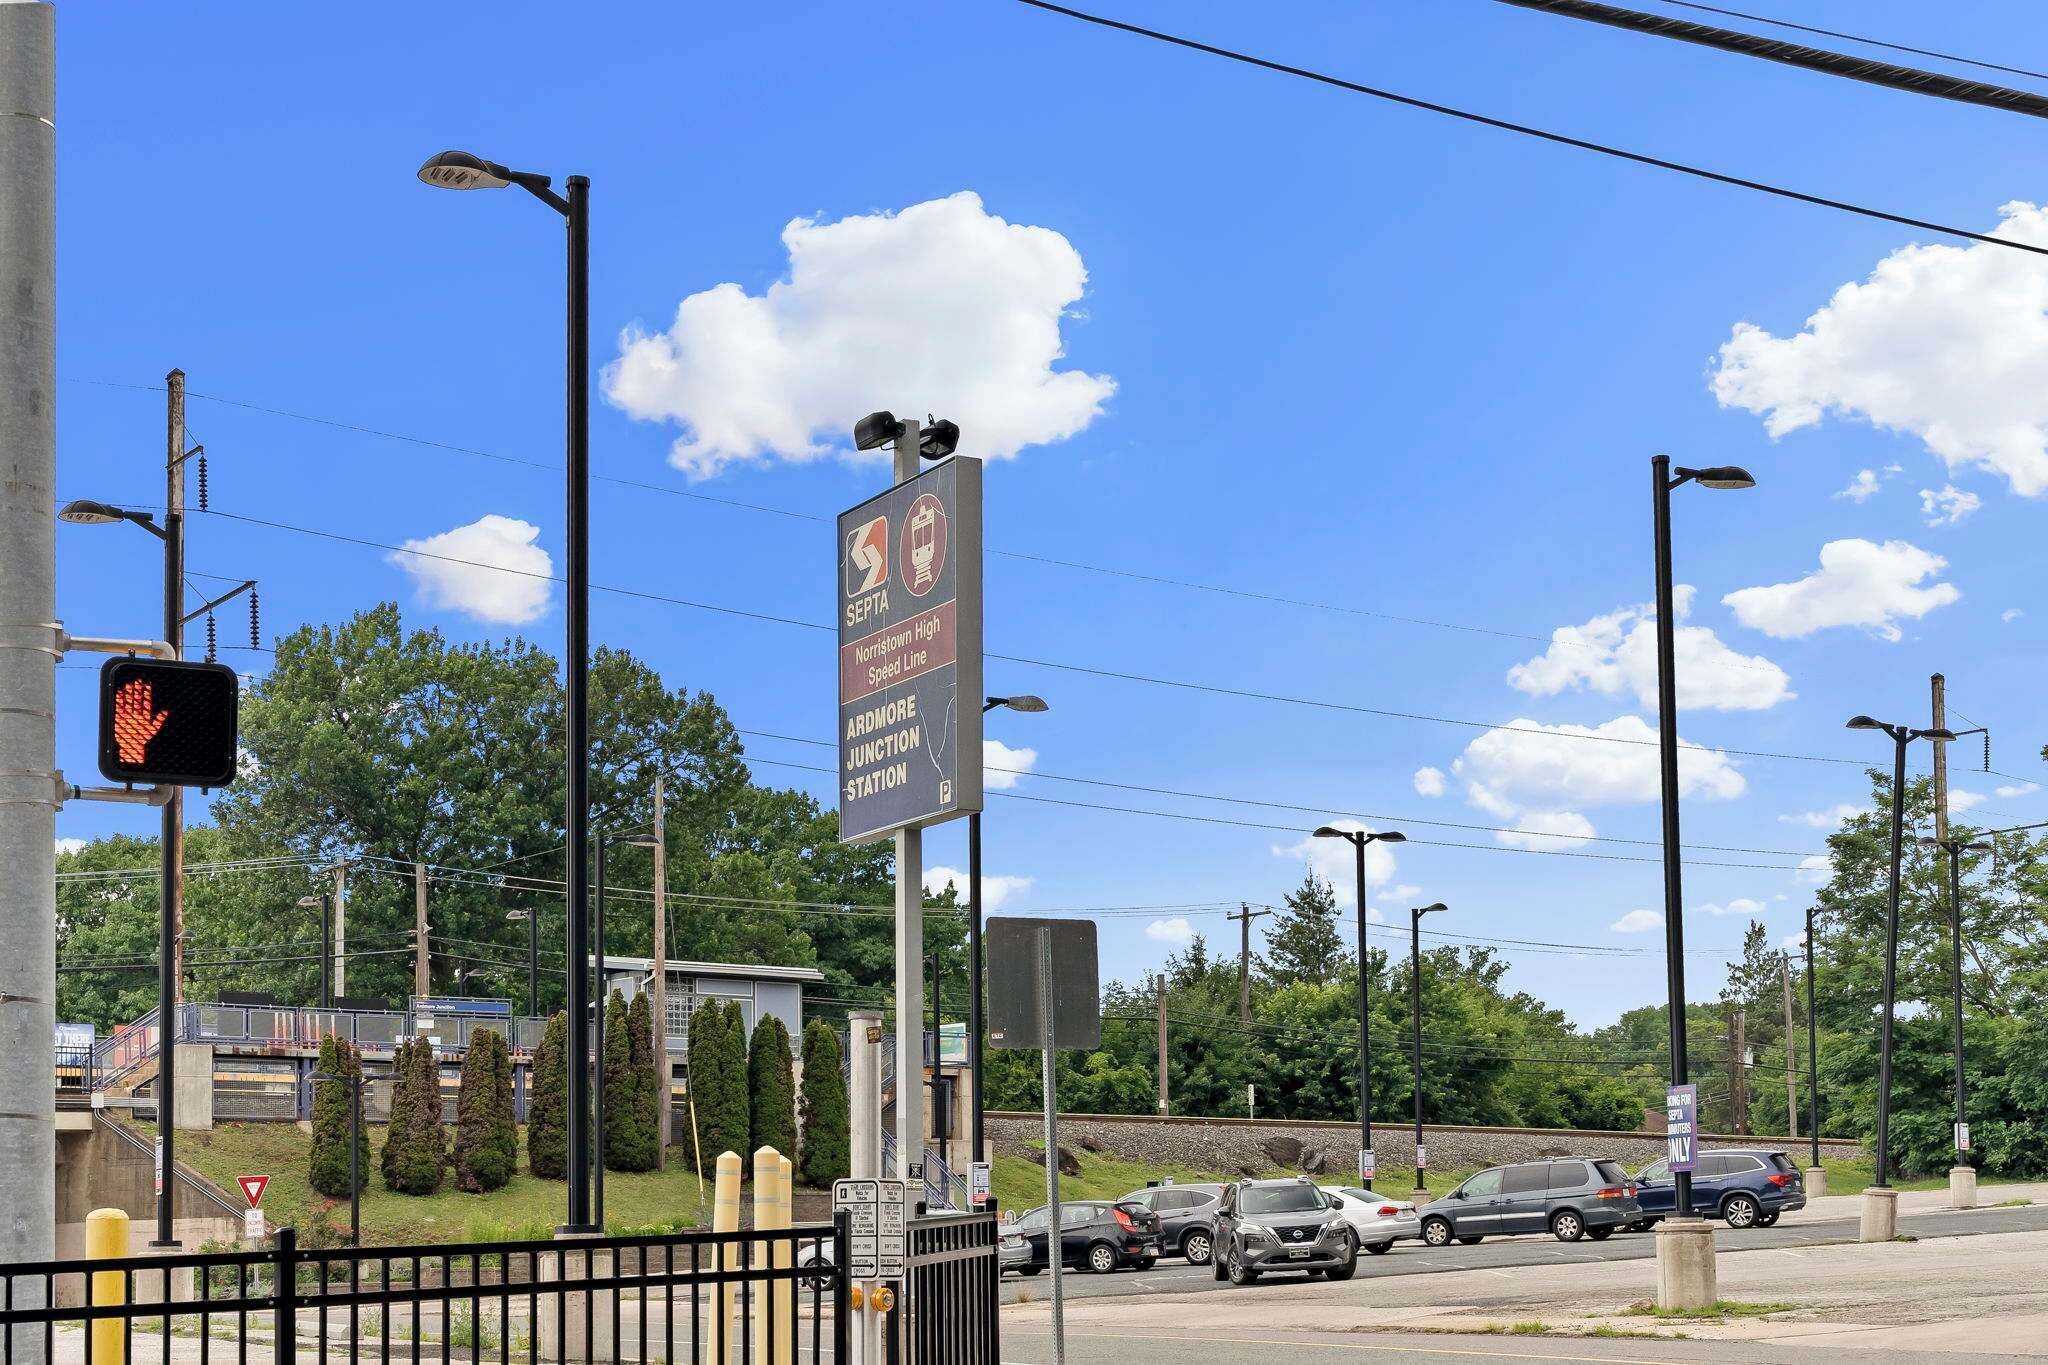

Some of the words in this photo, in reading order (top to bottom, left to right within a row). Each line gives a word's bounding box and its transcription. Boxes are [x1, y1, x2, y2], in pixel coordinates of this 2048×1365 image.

[846, 589, 890, 627] SEPTA
[855, 630, 912, 665] Norristown
[915, 615, 940, 641] High
[868, 656, 901, 687] Speed
[903, 650, 927, 671] Line
[846, 694, 916, 740] ARDMORE
[846, 725, 920, 771] JUNCTION
[847, 762, 907, 802] STATION
[941, 782, 950, 803] P
[1668, 1108, 1683, 1121] SEPTA
[1681, 1093, 1692, 1105] FOR
